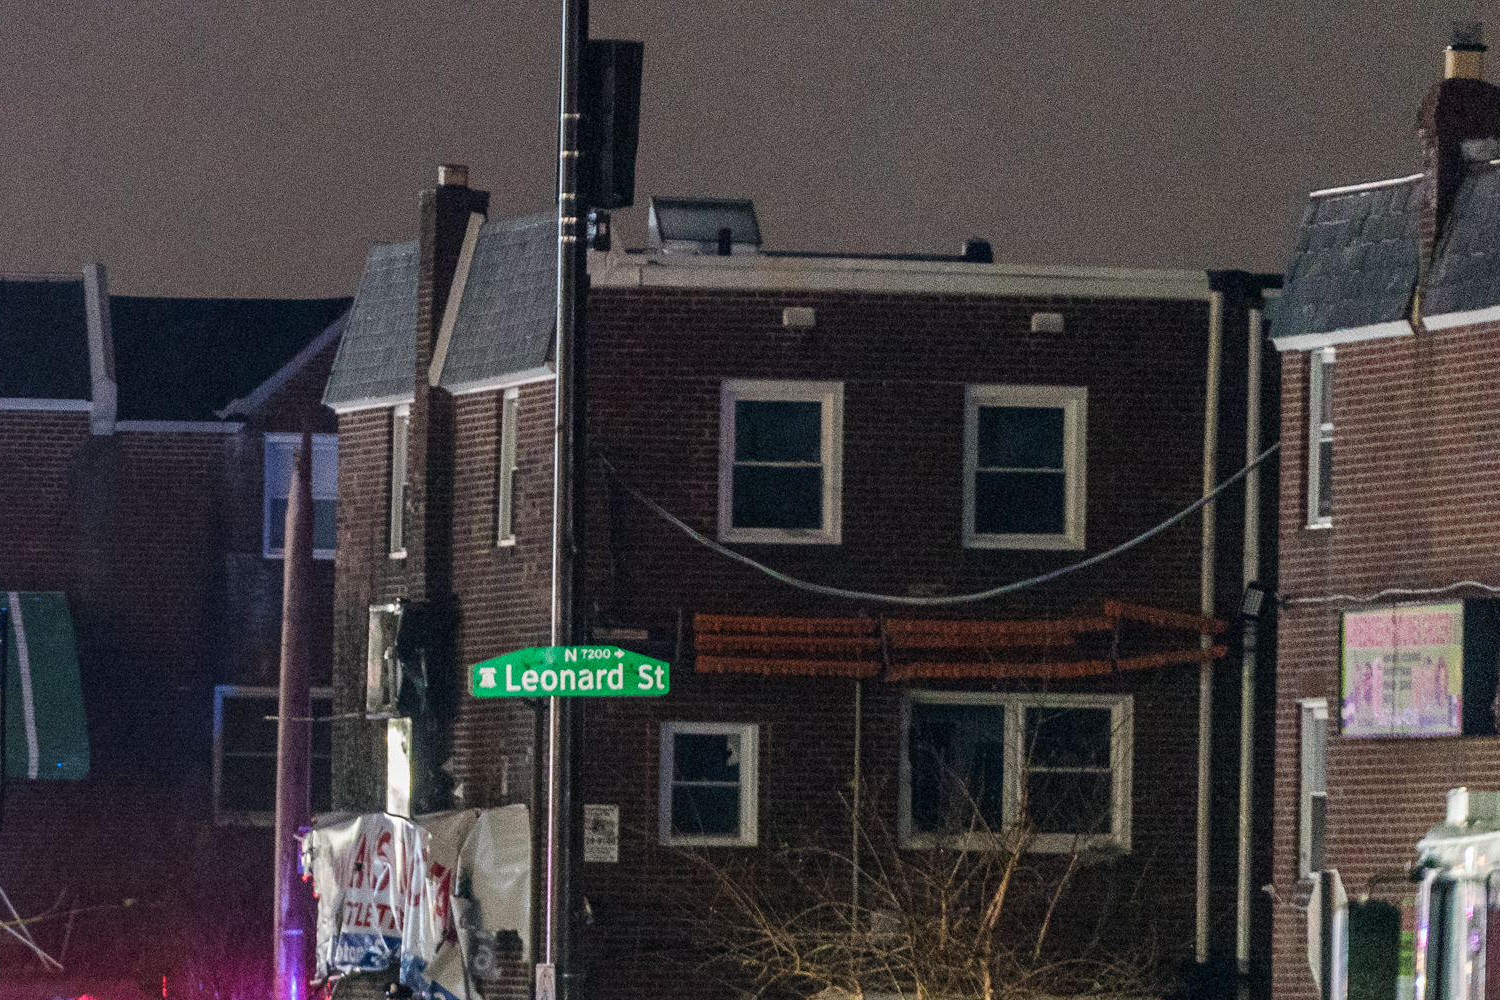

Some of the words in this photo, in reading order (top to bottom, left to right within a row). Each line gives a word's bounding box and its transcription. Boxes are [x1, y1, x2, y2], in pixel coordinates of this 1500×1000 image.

[564, 649, 577, 663] N
[581, 648, 611, 659] 7200
[505, 663, 624, 692] Leonard
[637, 664, 665, 691] St
